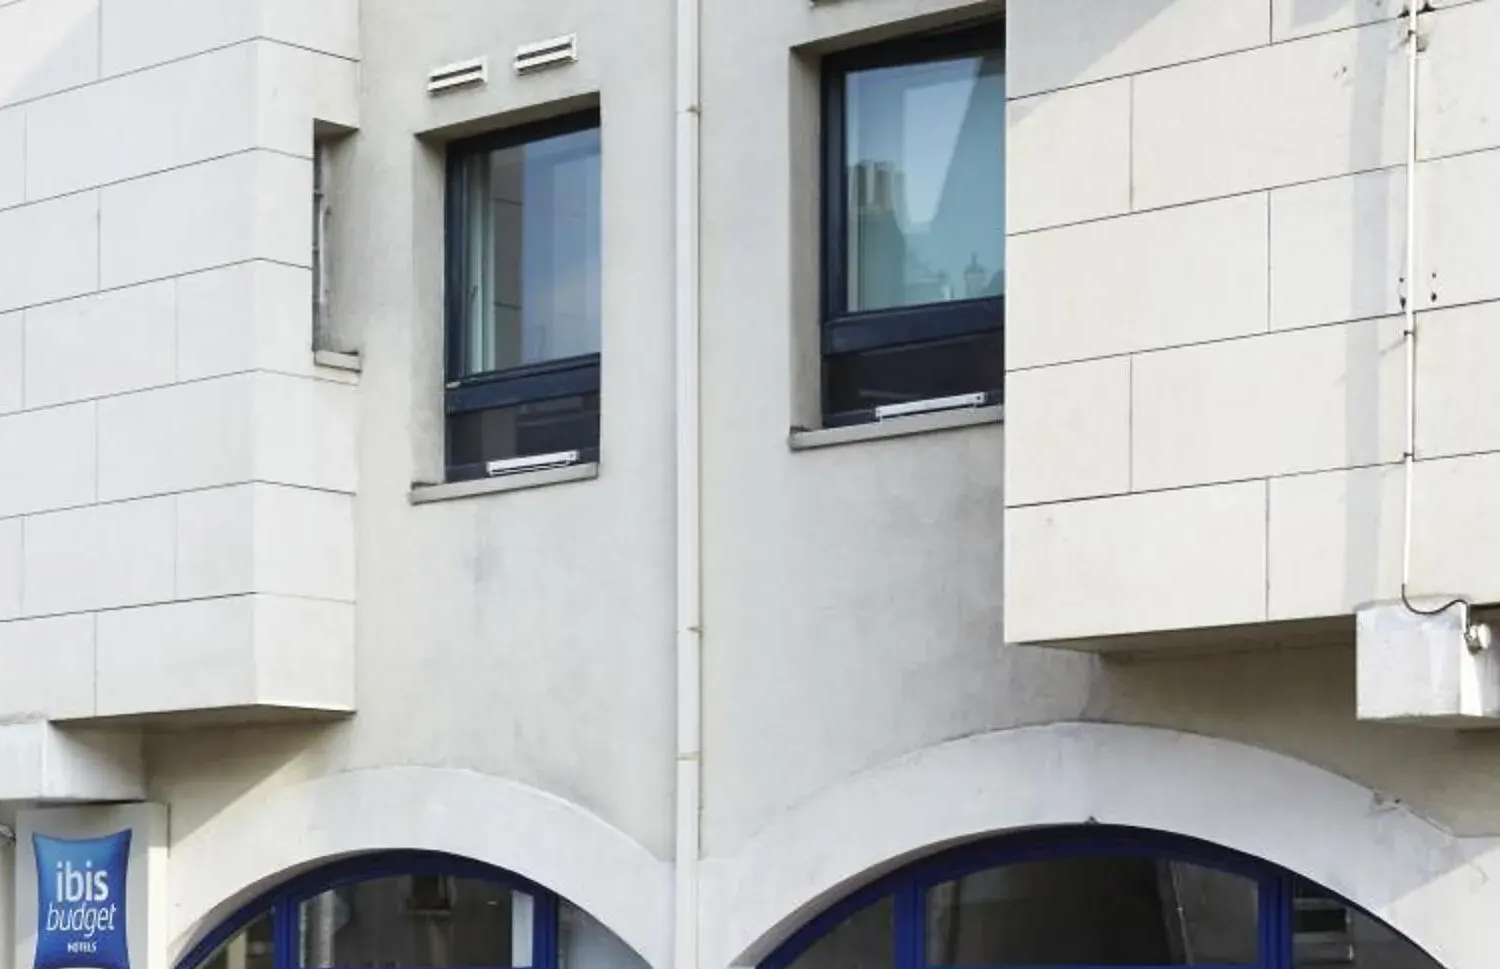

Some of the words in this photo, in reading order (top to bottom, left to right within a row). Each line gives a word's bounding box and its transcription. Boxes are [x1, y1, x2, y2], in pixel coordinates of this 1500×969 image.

[56, 860, 108, 902] ibis
[46, 902, 116, 937] budget
[67, 941, 97, 953] HOTELS
